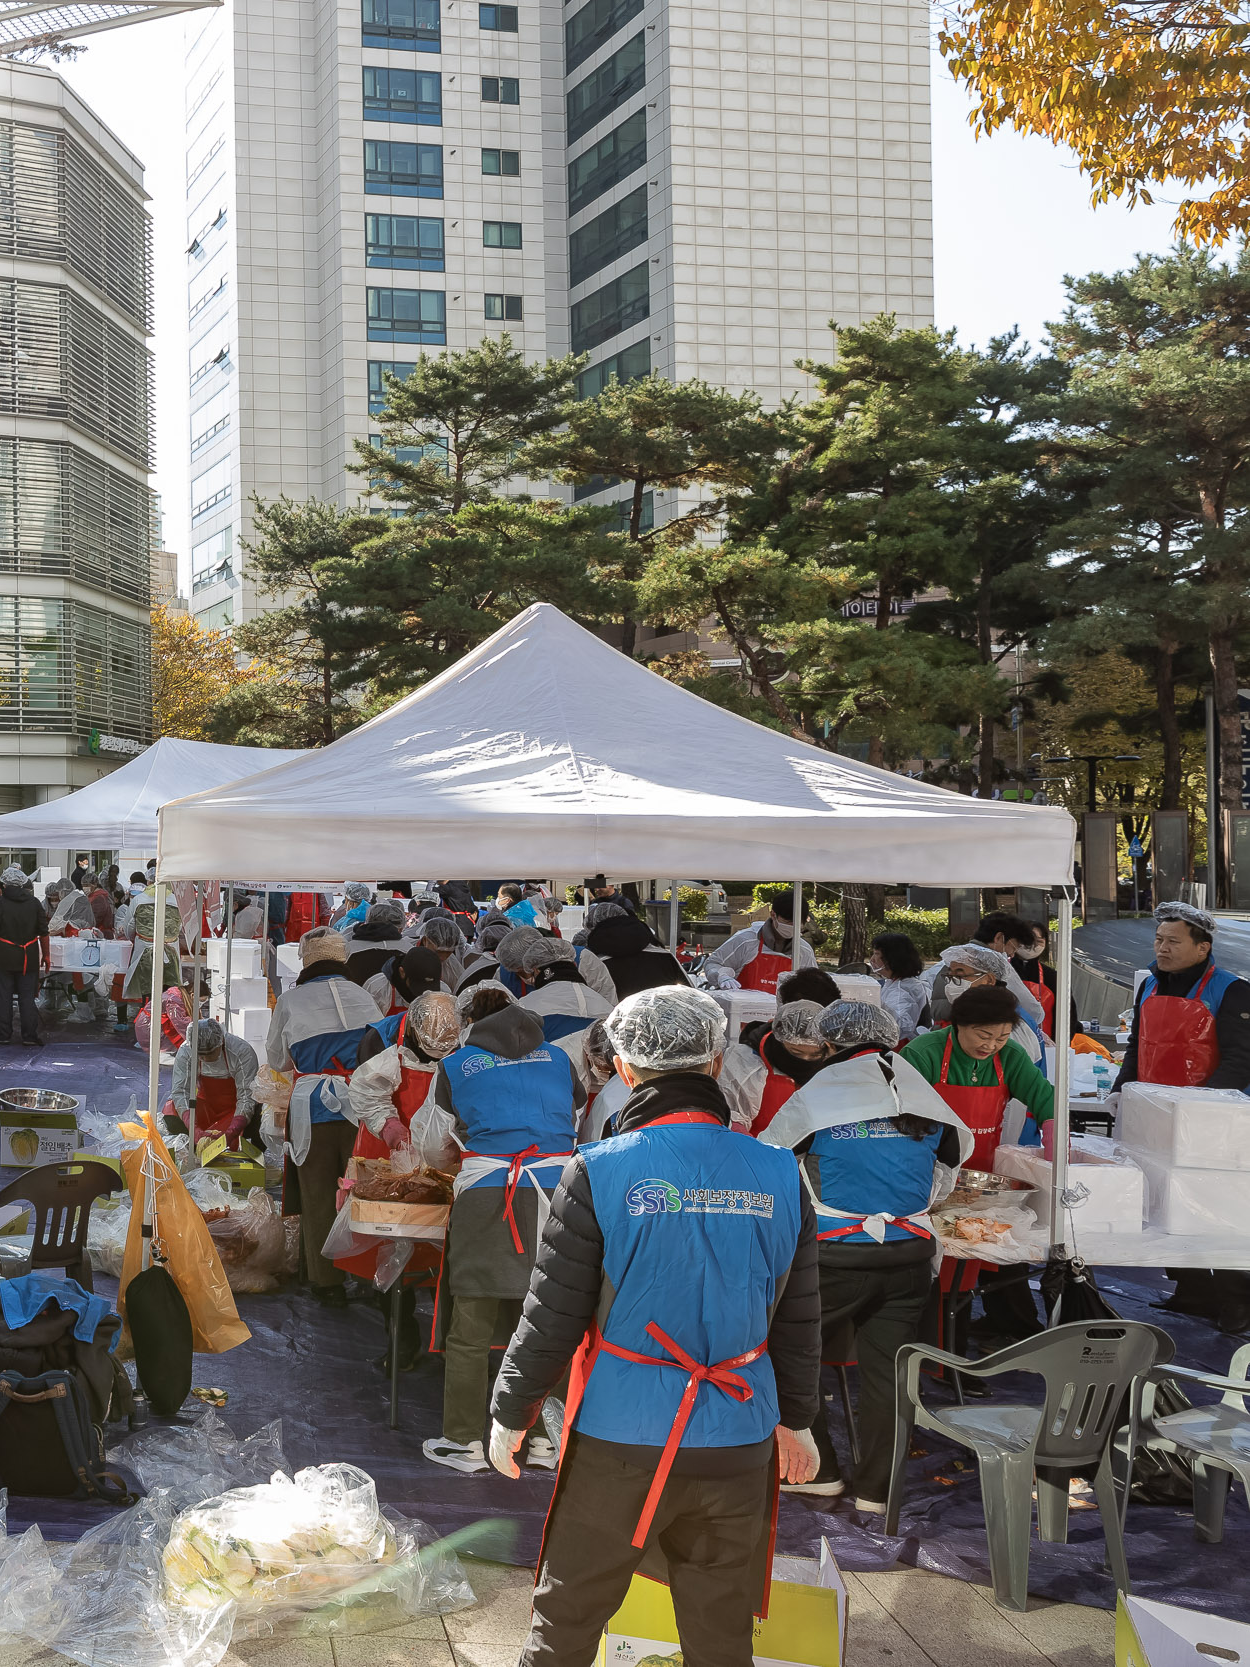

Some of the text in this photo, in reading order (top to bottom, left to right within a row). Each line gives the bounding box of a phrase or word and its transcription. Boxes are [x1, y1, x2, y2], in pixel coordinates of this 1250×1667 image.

[39, 1141, 74, 1152] 절임배추
[626, 1179, 682, 1216] SSiS
[682, 1188, 774, 1212] 사회보장정보원
